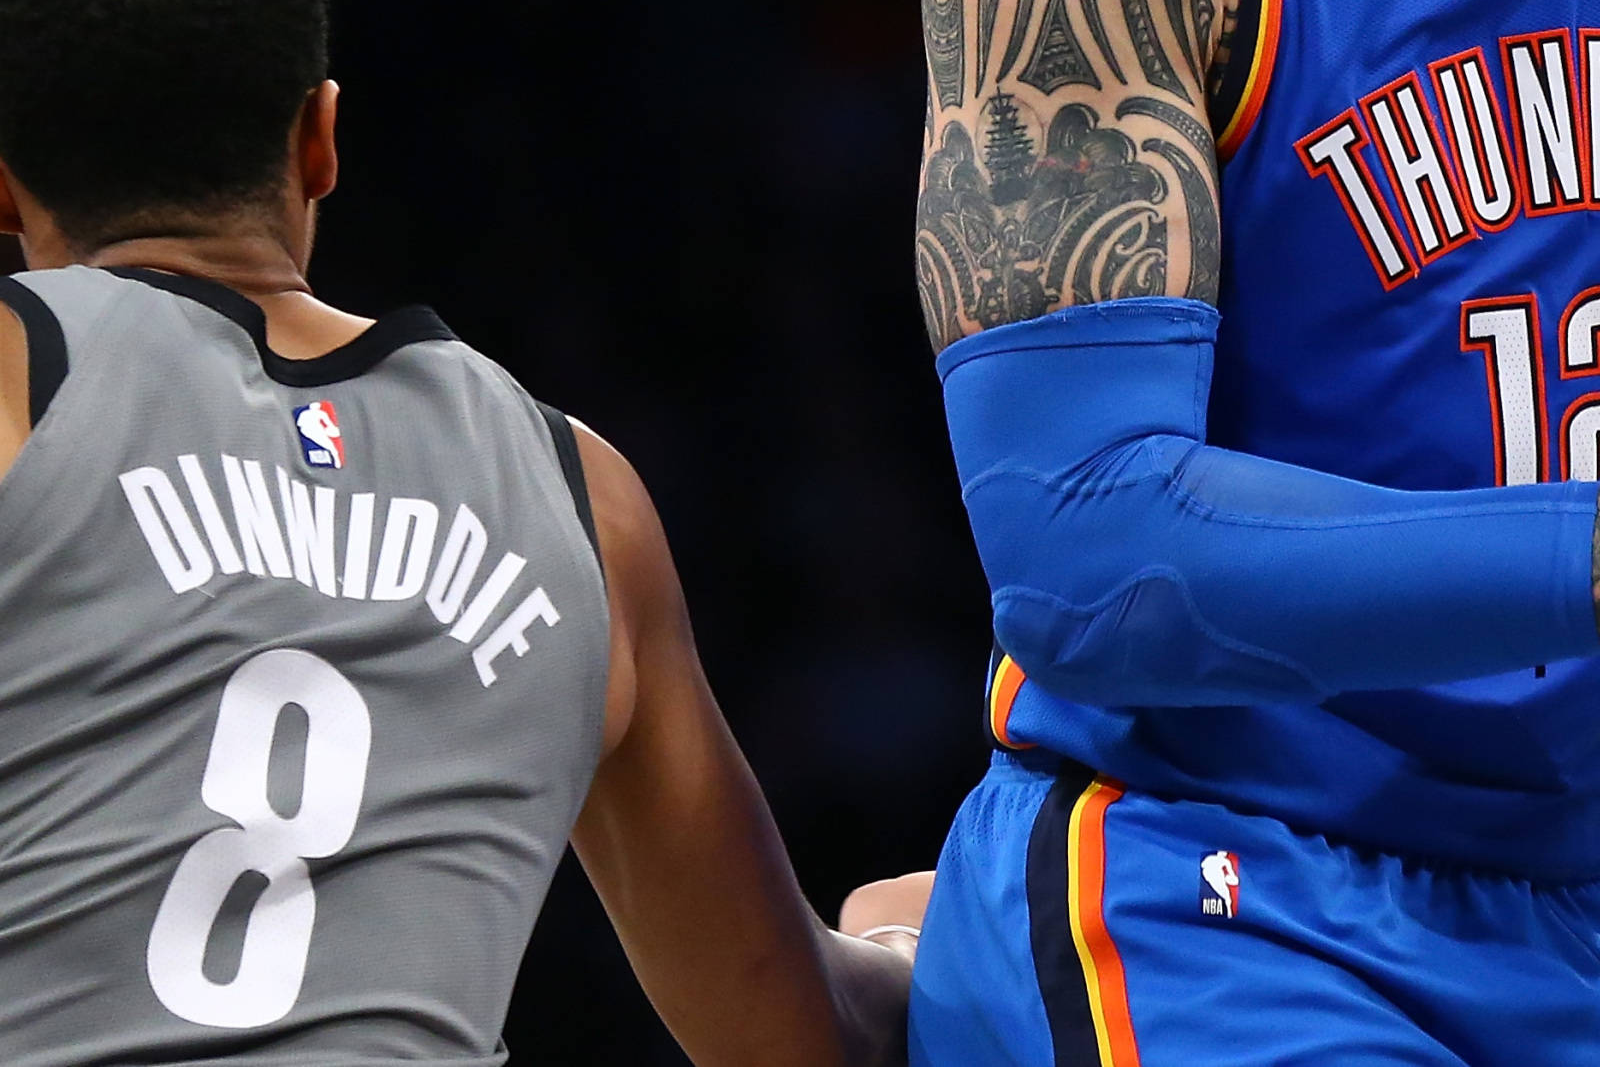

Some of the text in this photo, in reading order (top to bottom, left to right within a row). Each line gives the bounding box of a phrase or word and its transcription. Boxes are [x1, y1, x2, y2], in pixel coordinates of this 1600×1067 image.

[118, 452, 561, 689] DINWIDDIE
[146, 648, 373, 1029] 8
[1202, 897, 1224, 916] NBA
